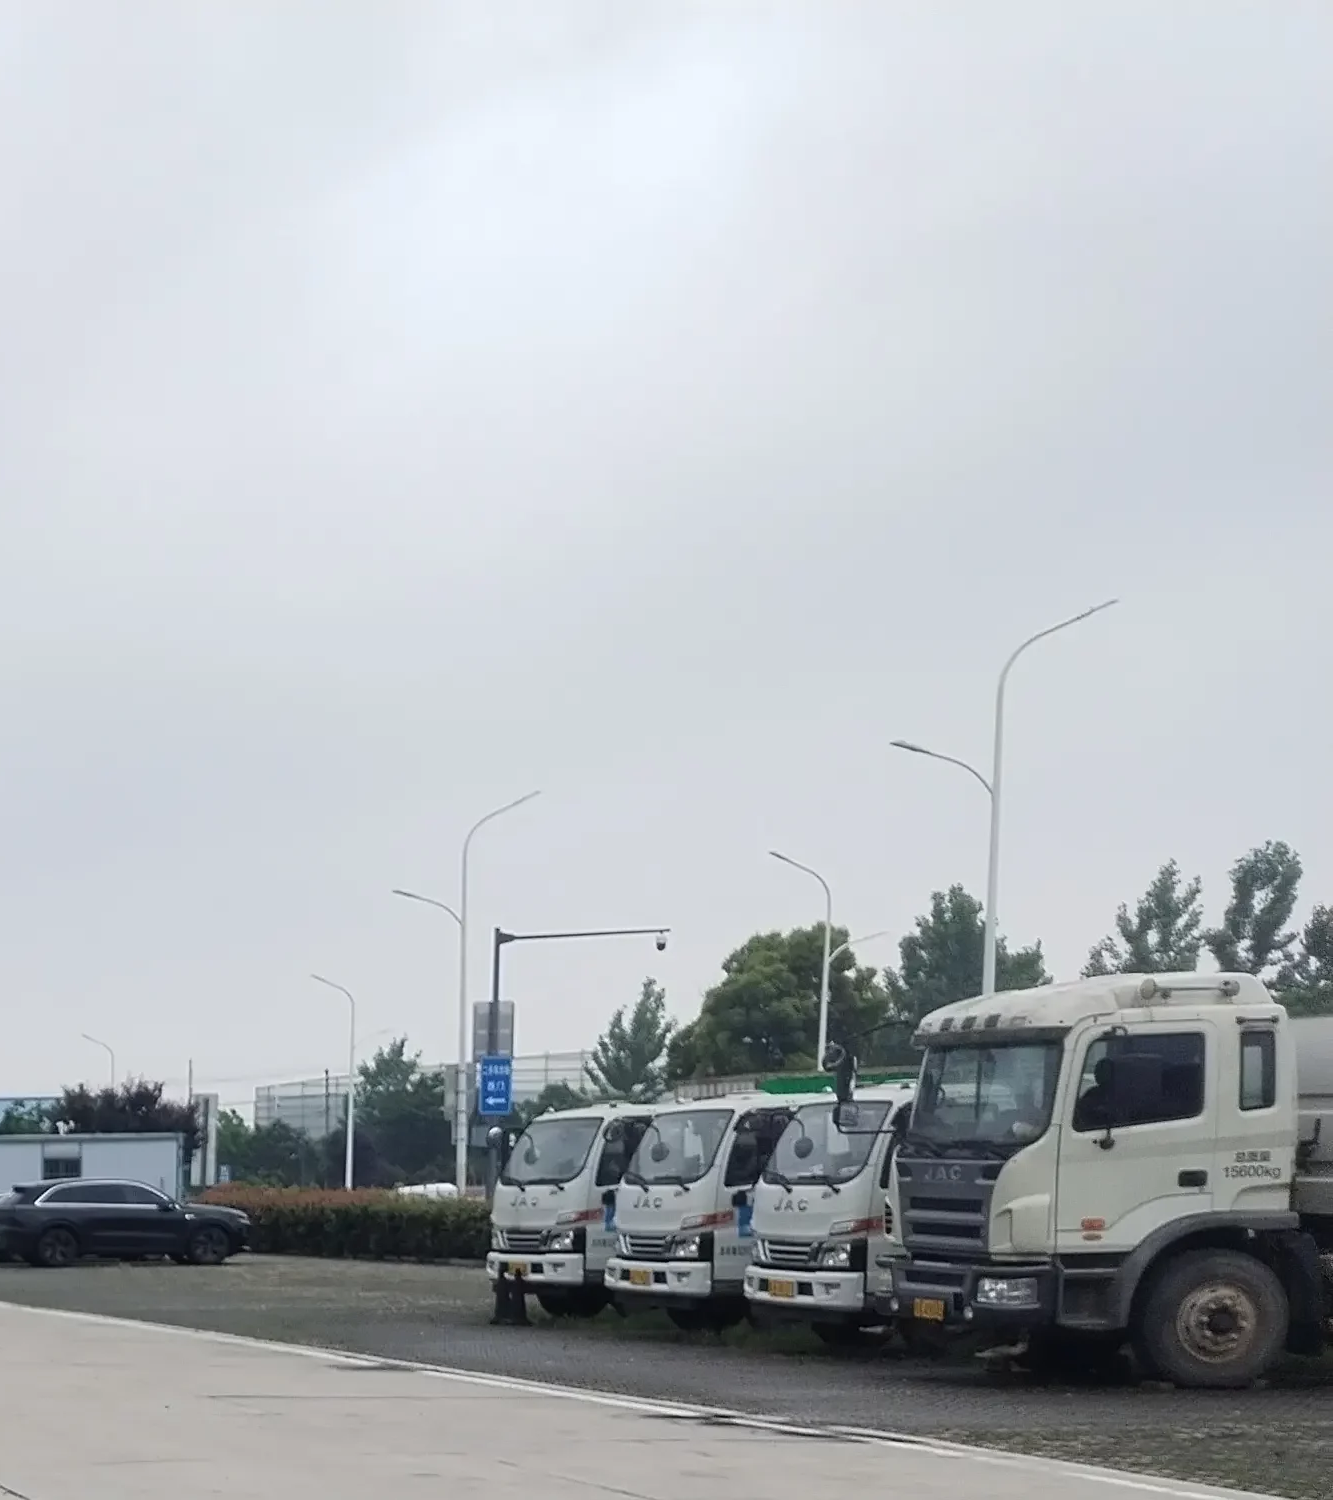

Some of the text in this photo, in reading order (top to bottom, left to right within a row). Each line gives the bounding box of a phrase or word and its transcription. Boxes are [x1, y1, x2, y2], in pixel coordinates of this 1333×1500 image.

[924, 1165, 962, 1180] JAC
[633, 1196, 663, 1209] JAC
[773, 1198, 808, 1212] JAC
